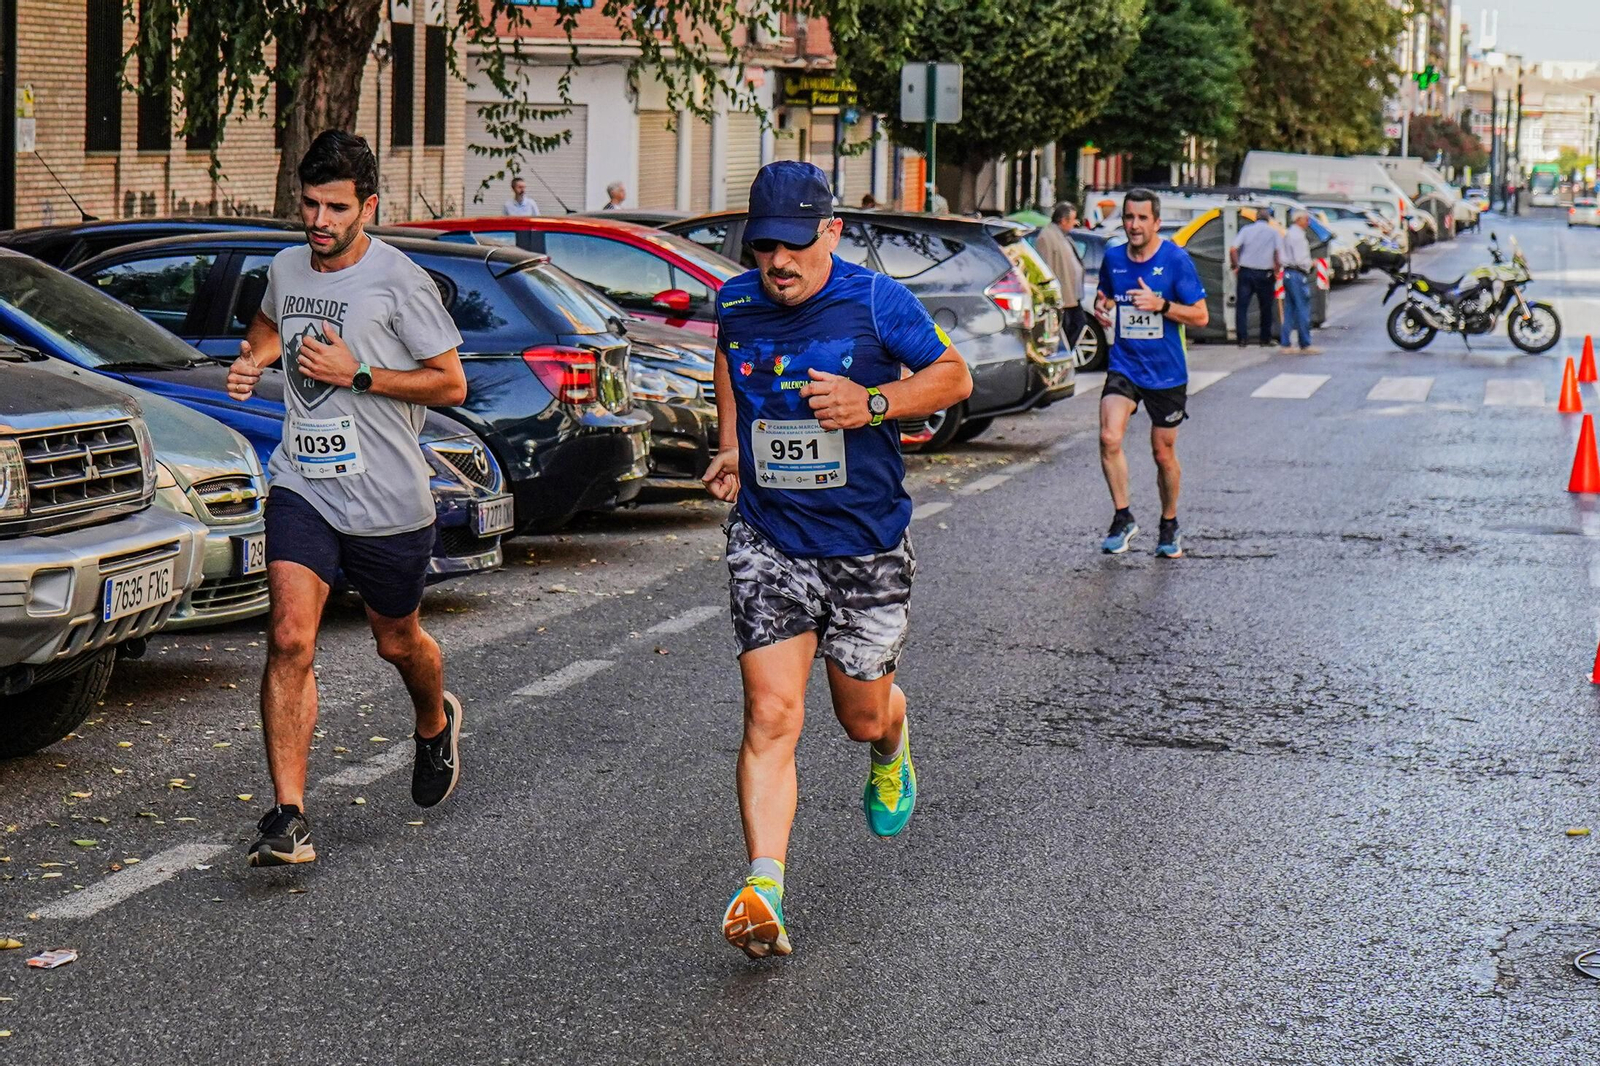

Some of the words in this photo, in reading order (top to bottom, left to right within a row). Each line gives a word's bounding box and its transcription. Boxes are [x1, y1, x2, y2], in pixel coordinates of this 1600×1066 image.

[282, 295, 348, 322] IRONSIDE
[1129, 315, 1151, 325] 341
[781, 381, 808, 390] VALENCIA
[295, 434, 346, 454] 1039
[770, 439, 819, 460] 951
[114, 575, 143, 613] 7635
[147, 568, 169, 603] FXG
